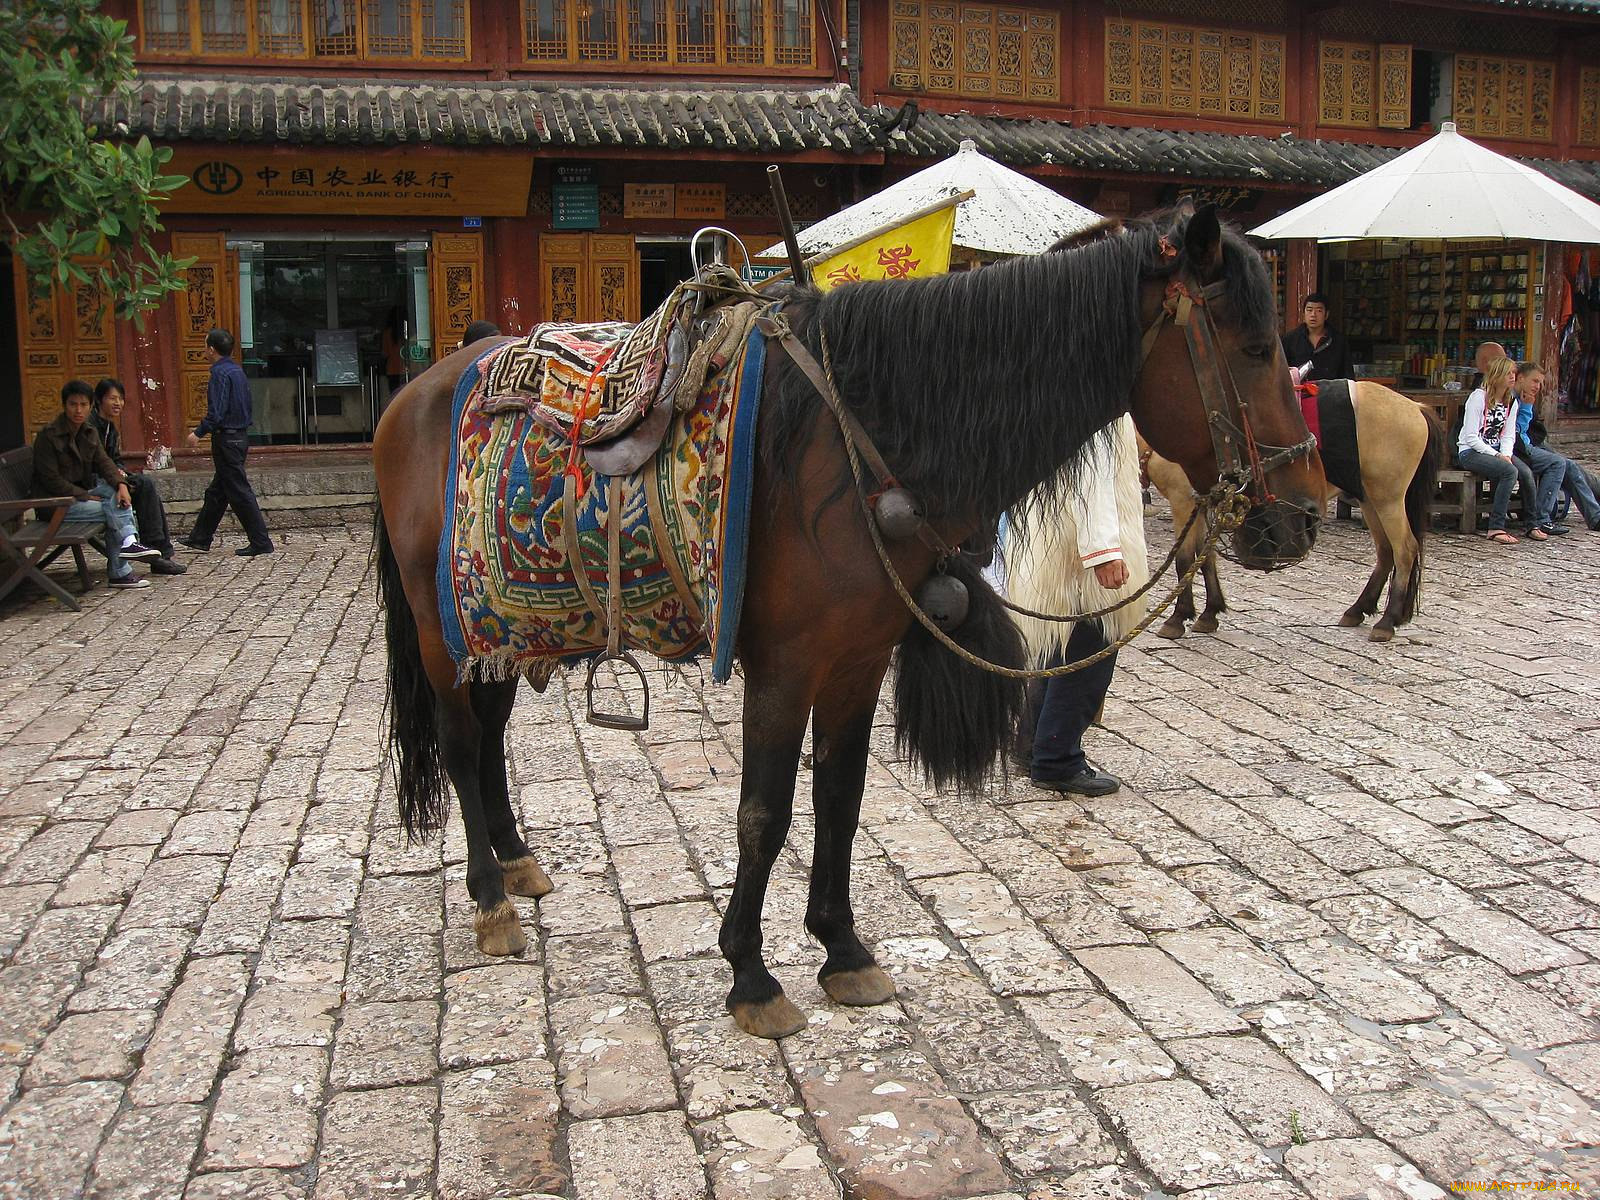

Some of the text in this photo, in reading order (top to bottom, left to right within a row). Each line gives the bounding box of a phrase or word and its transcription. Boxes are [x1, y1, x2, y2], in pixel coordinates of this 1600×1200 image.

[256, 166, 454, 189] 中国农业银行
[256, 190, 353, 198] AGRICULTURAL
